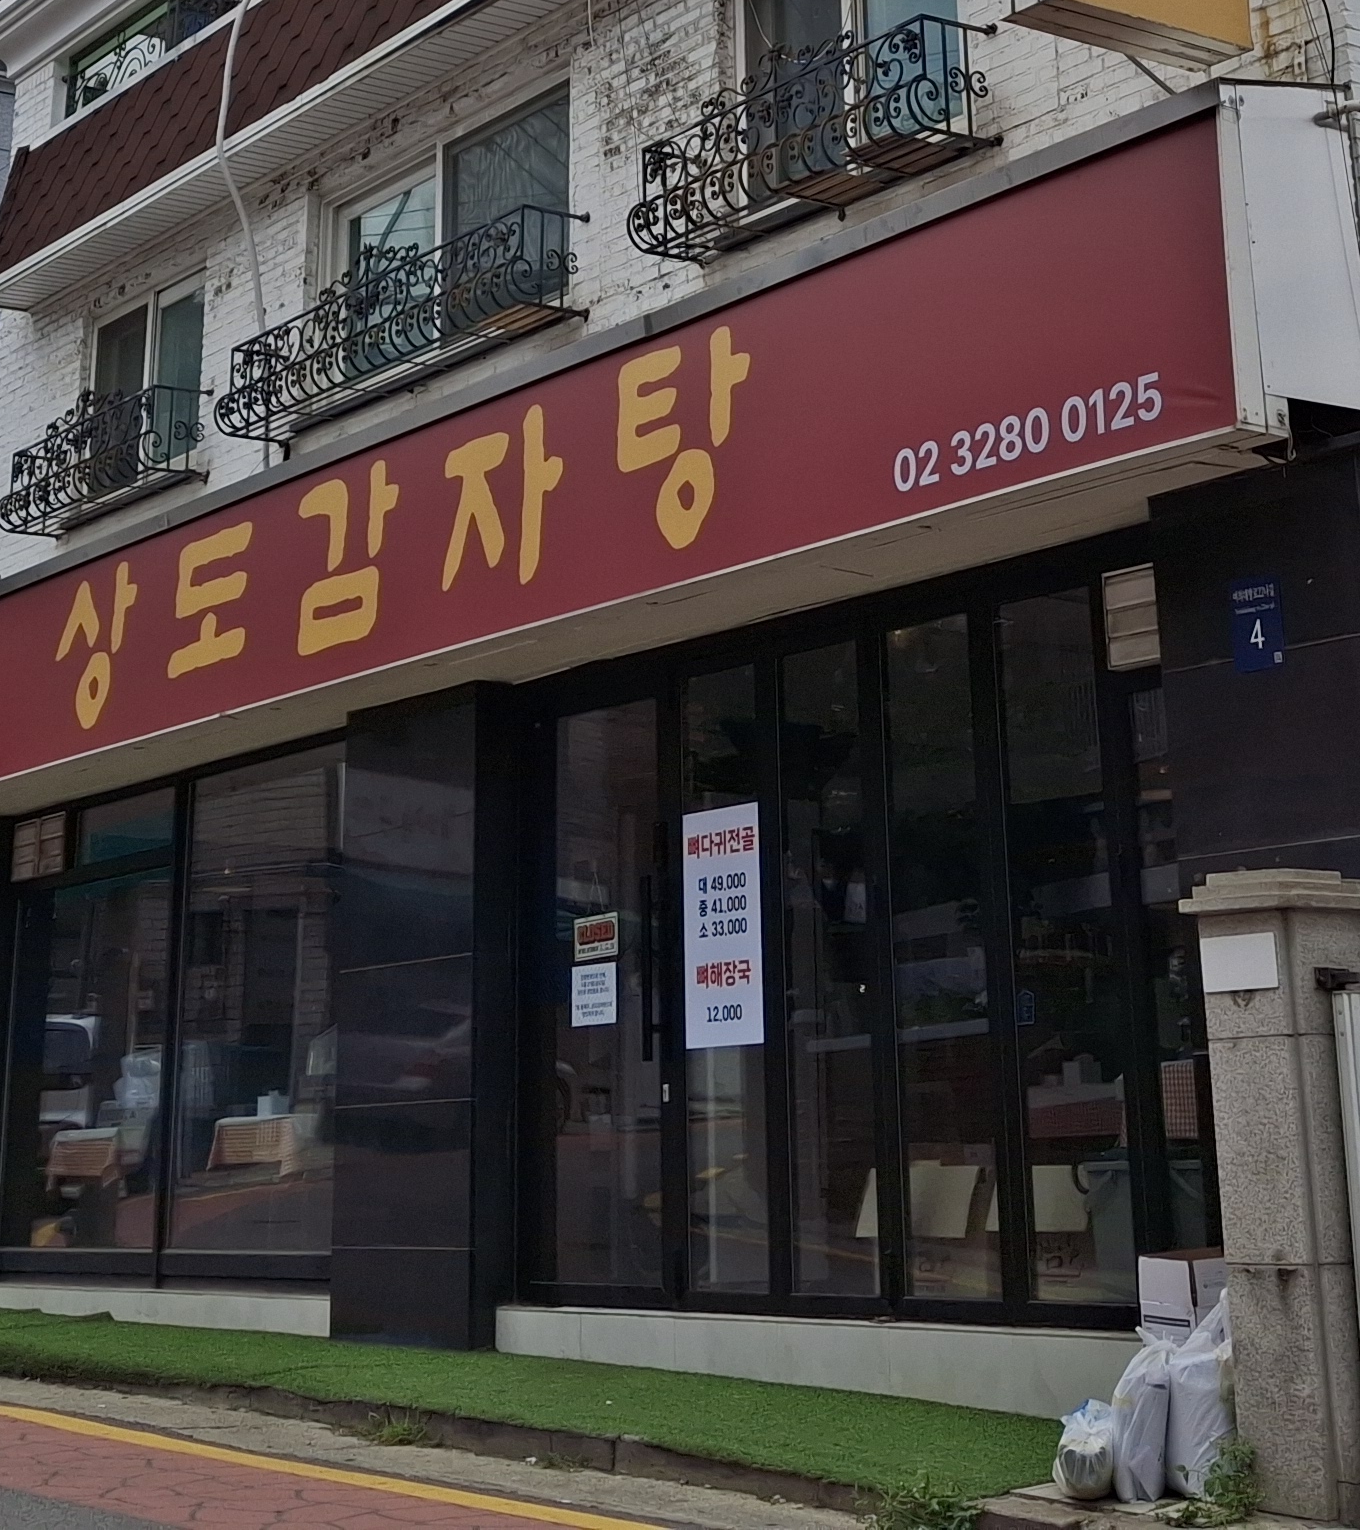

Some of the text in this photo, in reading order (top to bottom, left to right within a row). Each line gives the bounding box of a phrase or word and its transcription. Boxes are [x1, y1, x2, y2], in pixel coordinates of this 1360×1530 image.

[893, 371, 1163, 492] 02 3280 0125
[54, 326, 751, 730] 상도감자탕
[1249, 618, 1266, 650] 4
[687, 826, 756, 859] 뼈다귀전골
[698, 876, 708, 894] 대
[698, 899, 708, 917] 중
[698, 922, 709, 939] 소
[696, 959, 752, 989] 뼈해장국
